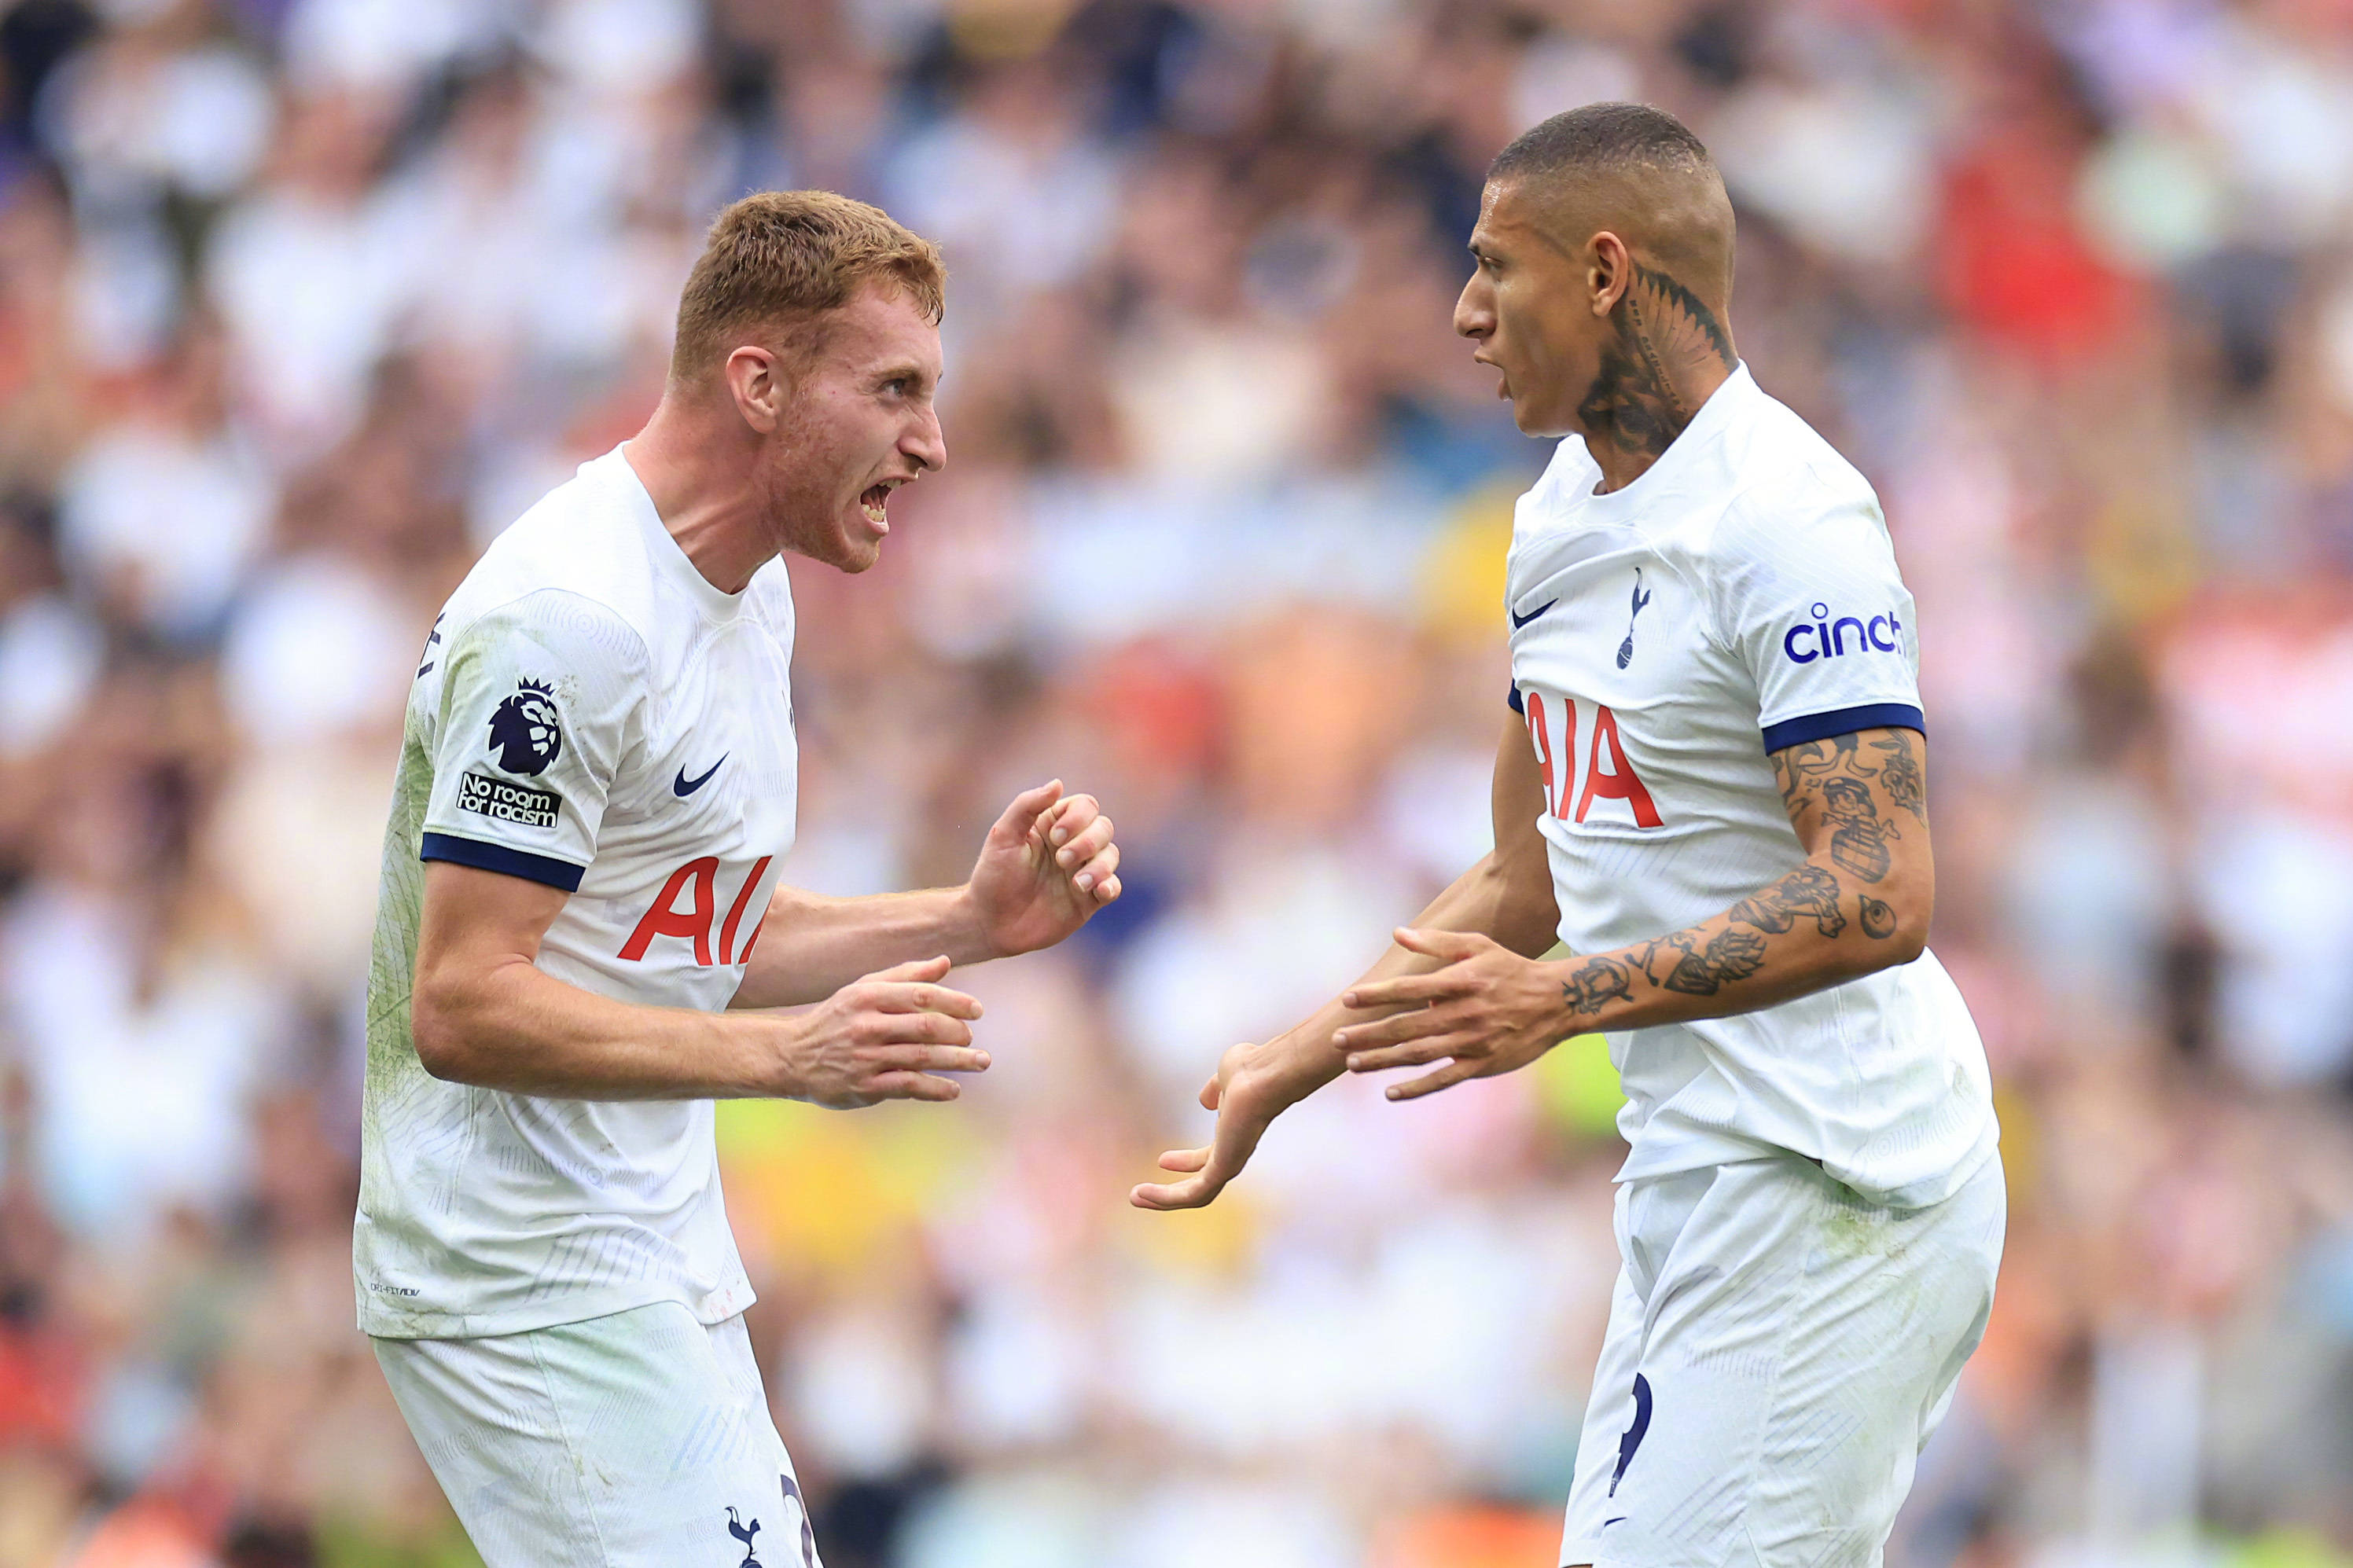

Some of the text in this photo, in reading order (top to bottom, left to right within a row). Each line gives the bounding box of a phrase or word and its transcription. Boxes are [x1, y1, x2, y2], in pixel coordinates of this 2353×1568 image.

[1784, 602, 1906, 664] cinch
[457, 790, 557, 828] for racism
[461, 773, 550, 810] No room
[616, 854, 774, 967] AI
